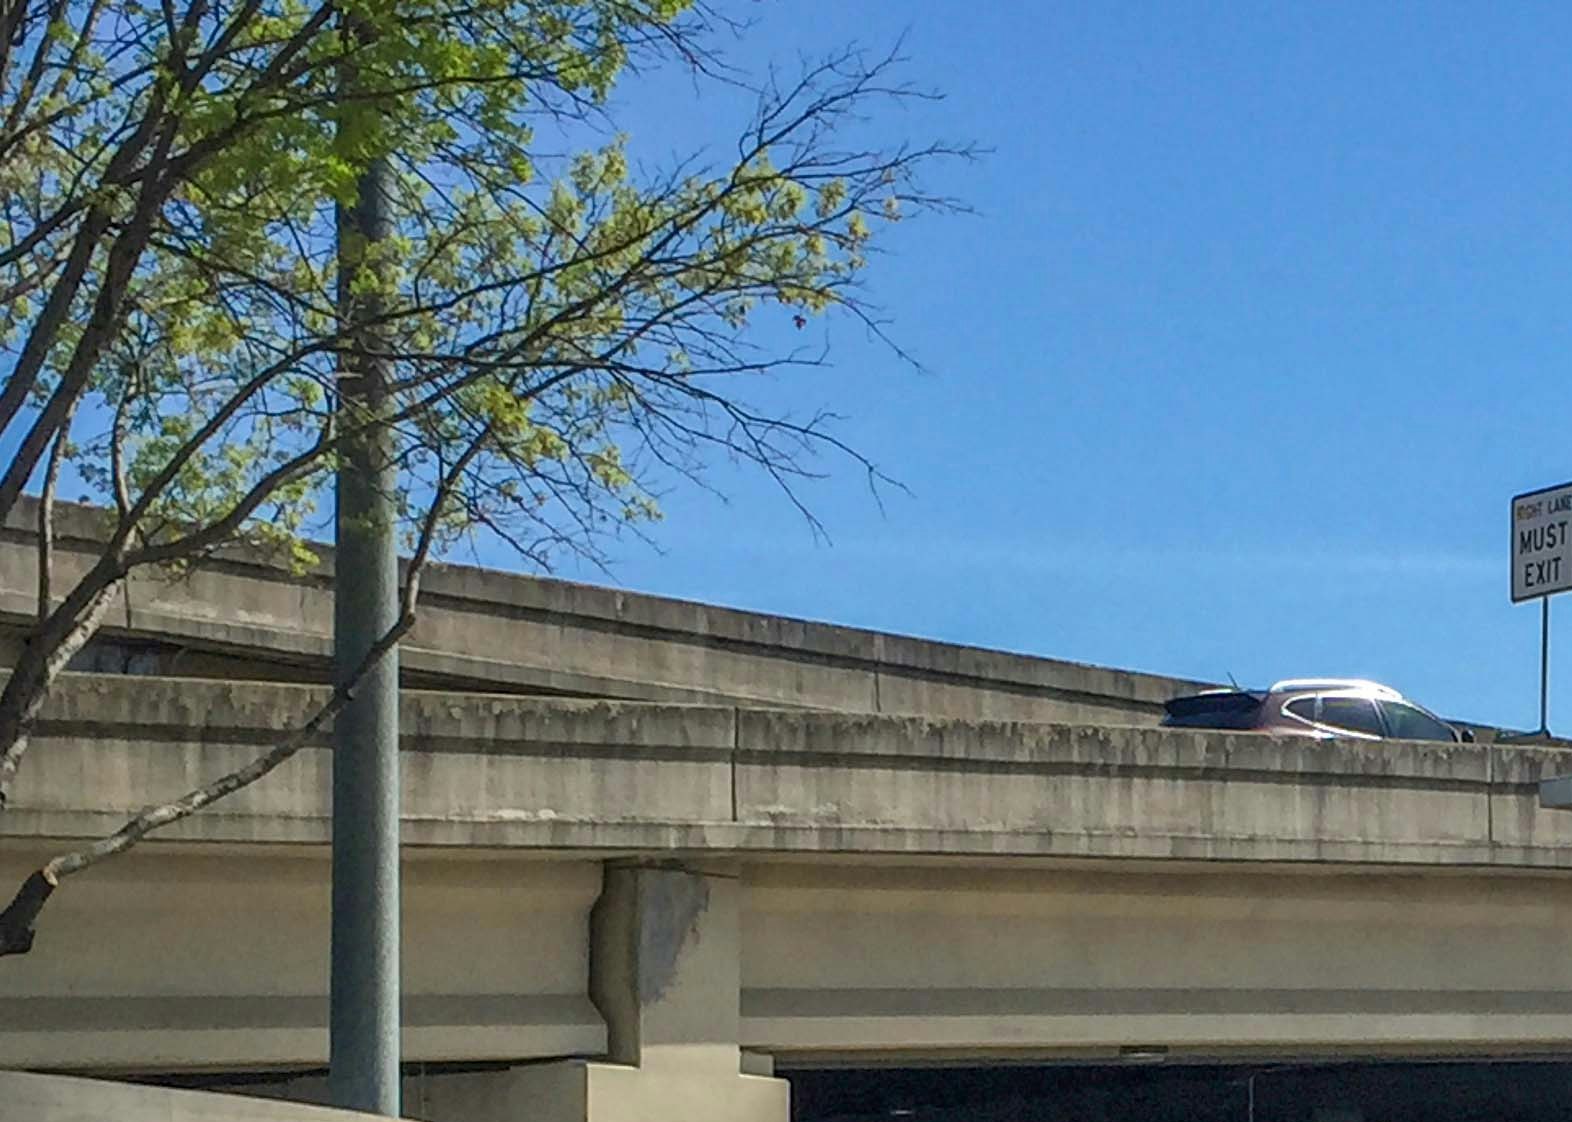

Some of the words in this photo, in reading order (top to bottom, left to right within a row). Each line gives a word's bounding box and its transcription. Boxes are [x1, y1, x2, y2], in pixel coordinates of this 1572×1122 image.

[1547, 495, 1572, 514] LANE
[1520, 521, 1568, 554] MUST
[1524, 557, 1561, 587] EXIT
